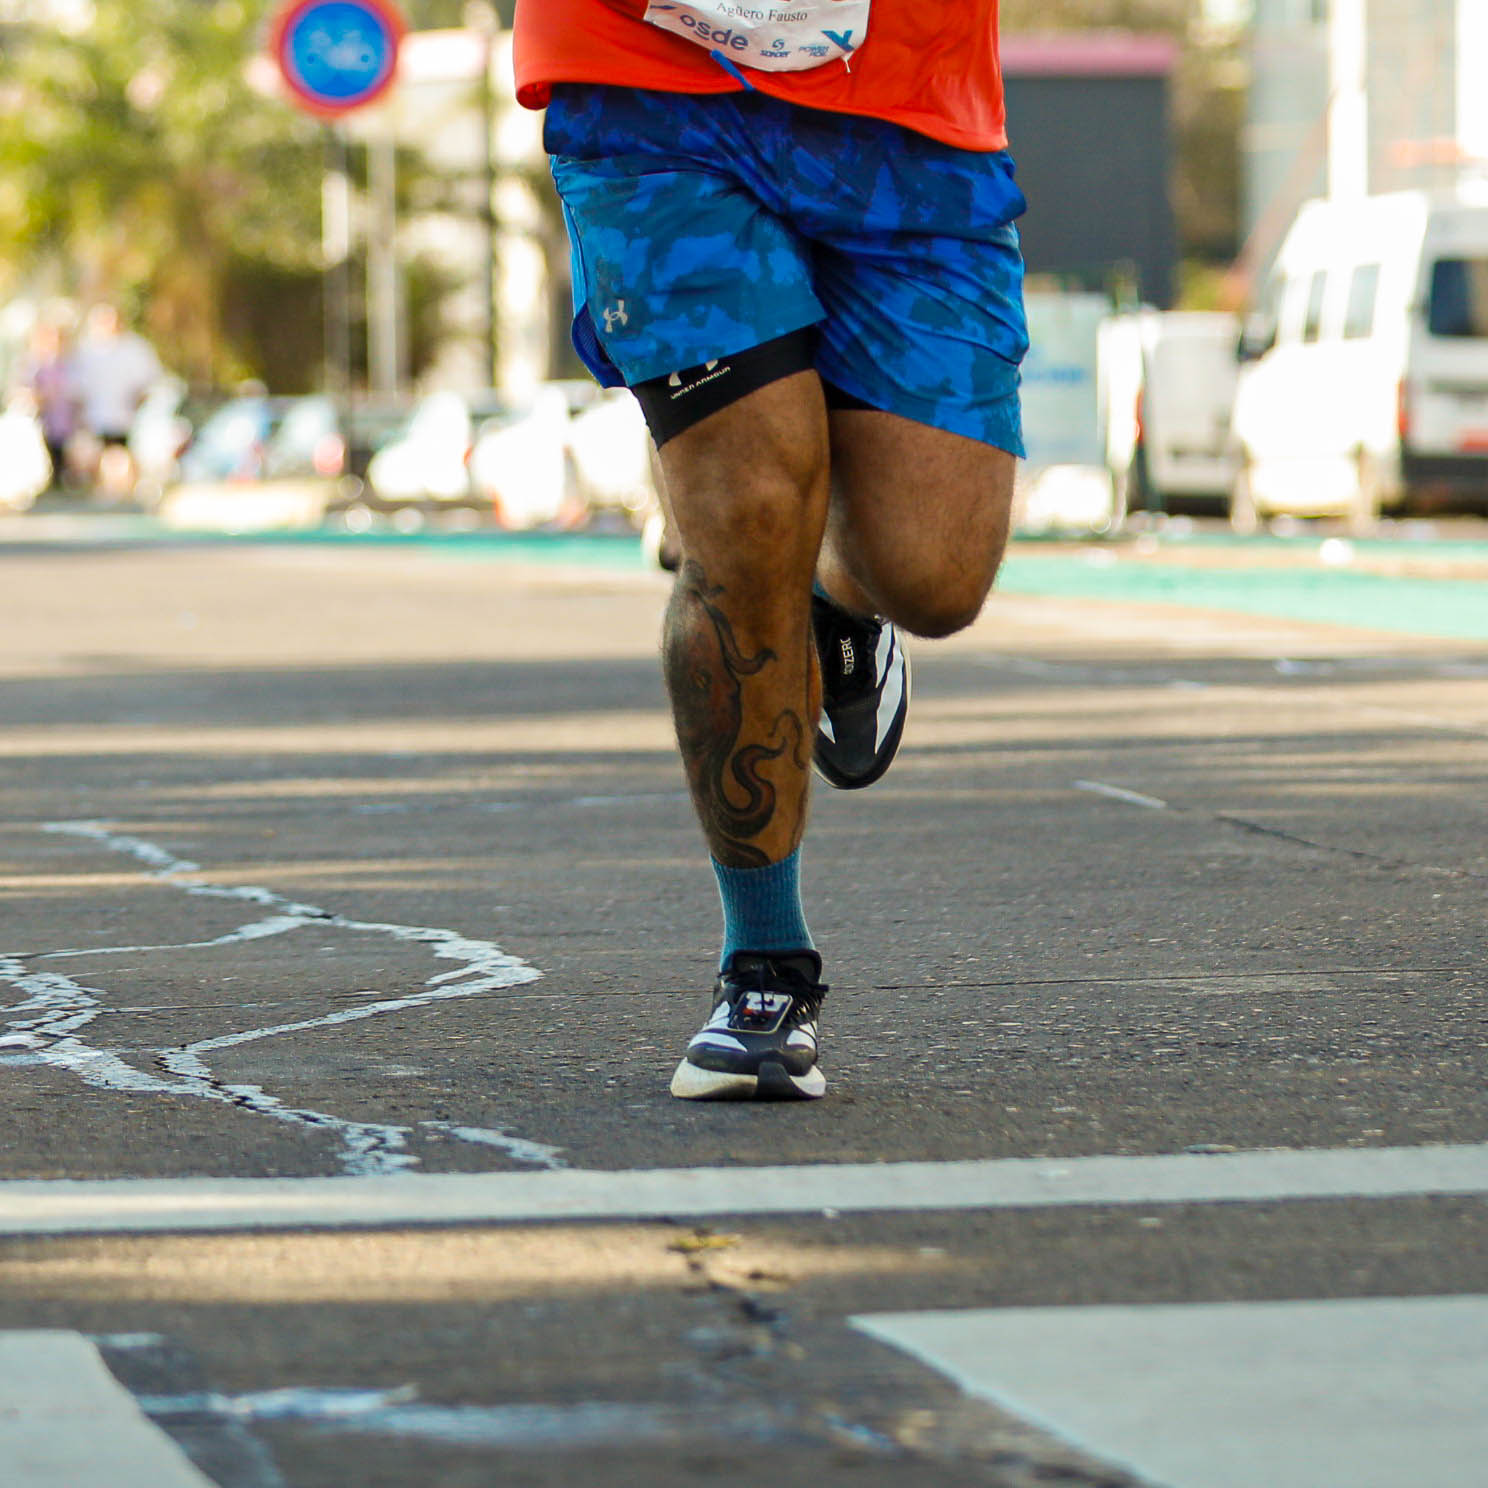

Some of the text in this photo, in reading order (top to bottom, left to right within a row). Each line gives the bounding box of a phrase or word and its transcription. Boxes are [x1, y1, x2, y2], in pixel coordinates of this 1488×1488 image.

[716, 2, 808, 22] Agüero Fausto
[680, 14, 748, 51] osde
